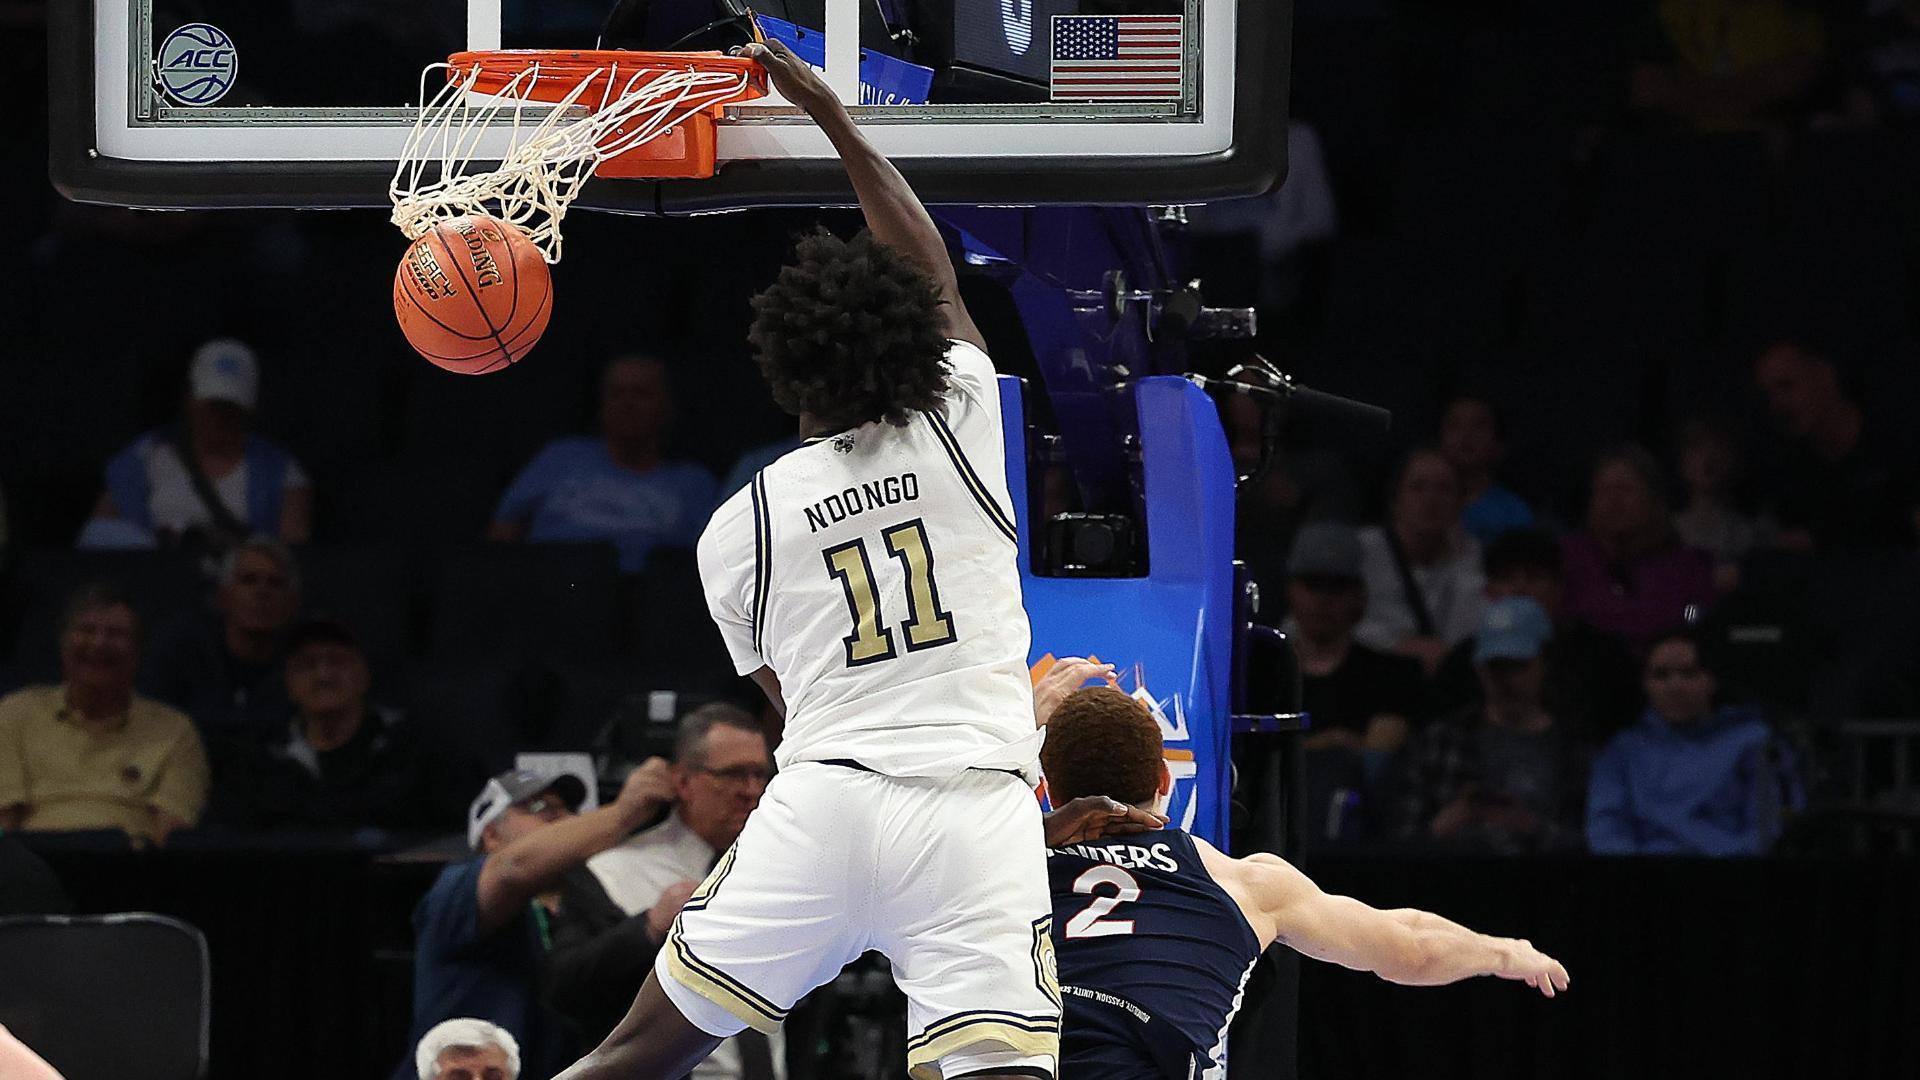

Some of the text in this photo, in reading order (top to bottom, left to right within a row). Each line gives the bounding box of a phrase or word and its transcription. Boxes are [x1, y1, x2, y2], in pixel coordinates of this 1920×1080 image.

[166, 49, 235, 68] ACC
[803, 471, 919, 533] NDONGO
[821, 517, 958, 668] 11
[1064, 864, 1143, 940] 2
